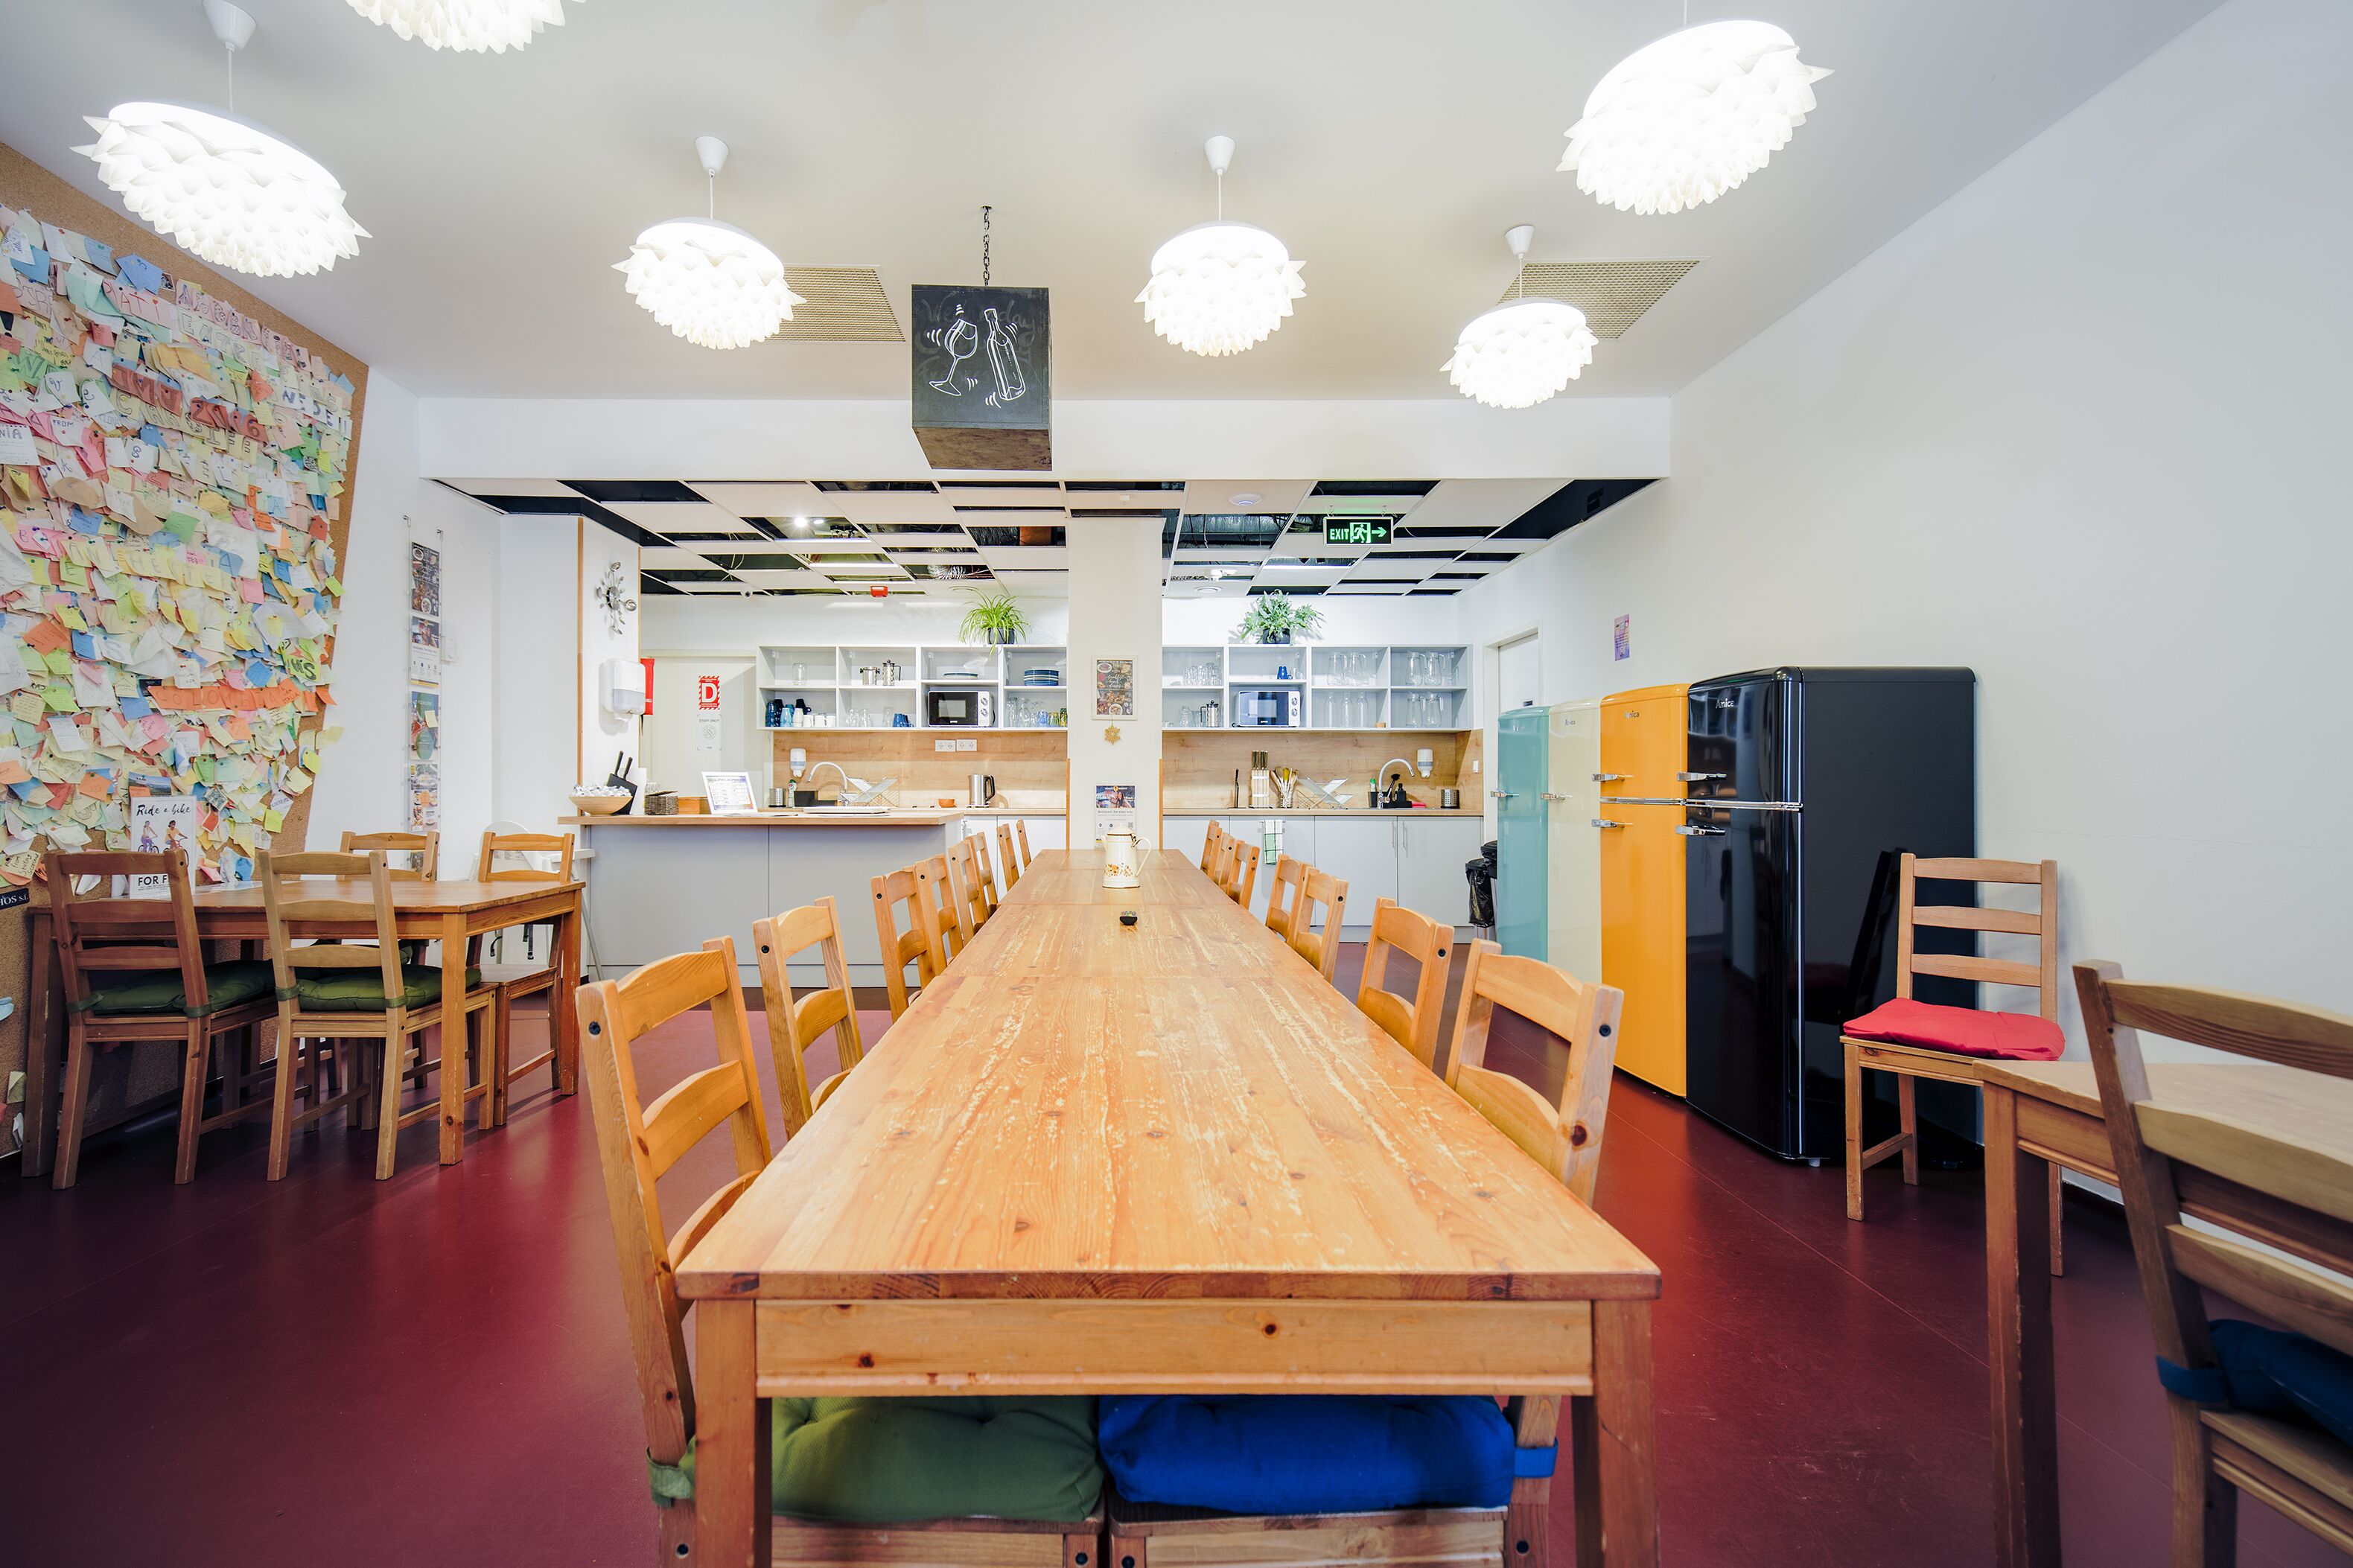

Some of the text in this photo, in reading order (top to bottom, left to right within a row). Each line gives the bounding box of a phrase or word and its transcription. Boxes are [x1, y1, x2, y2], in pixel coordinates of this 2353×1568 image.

[53, 419, 74, 428] FROM
[1330, 528, 1349, 541] EXIT
[701, 683, 718, 703] D
[1715, 697, 1735, 709] Amica
[136, 805, 160, 816] Ride
[171, 803, 191, 815] bike
[138, 875, 159, 886] FOR
